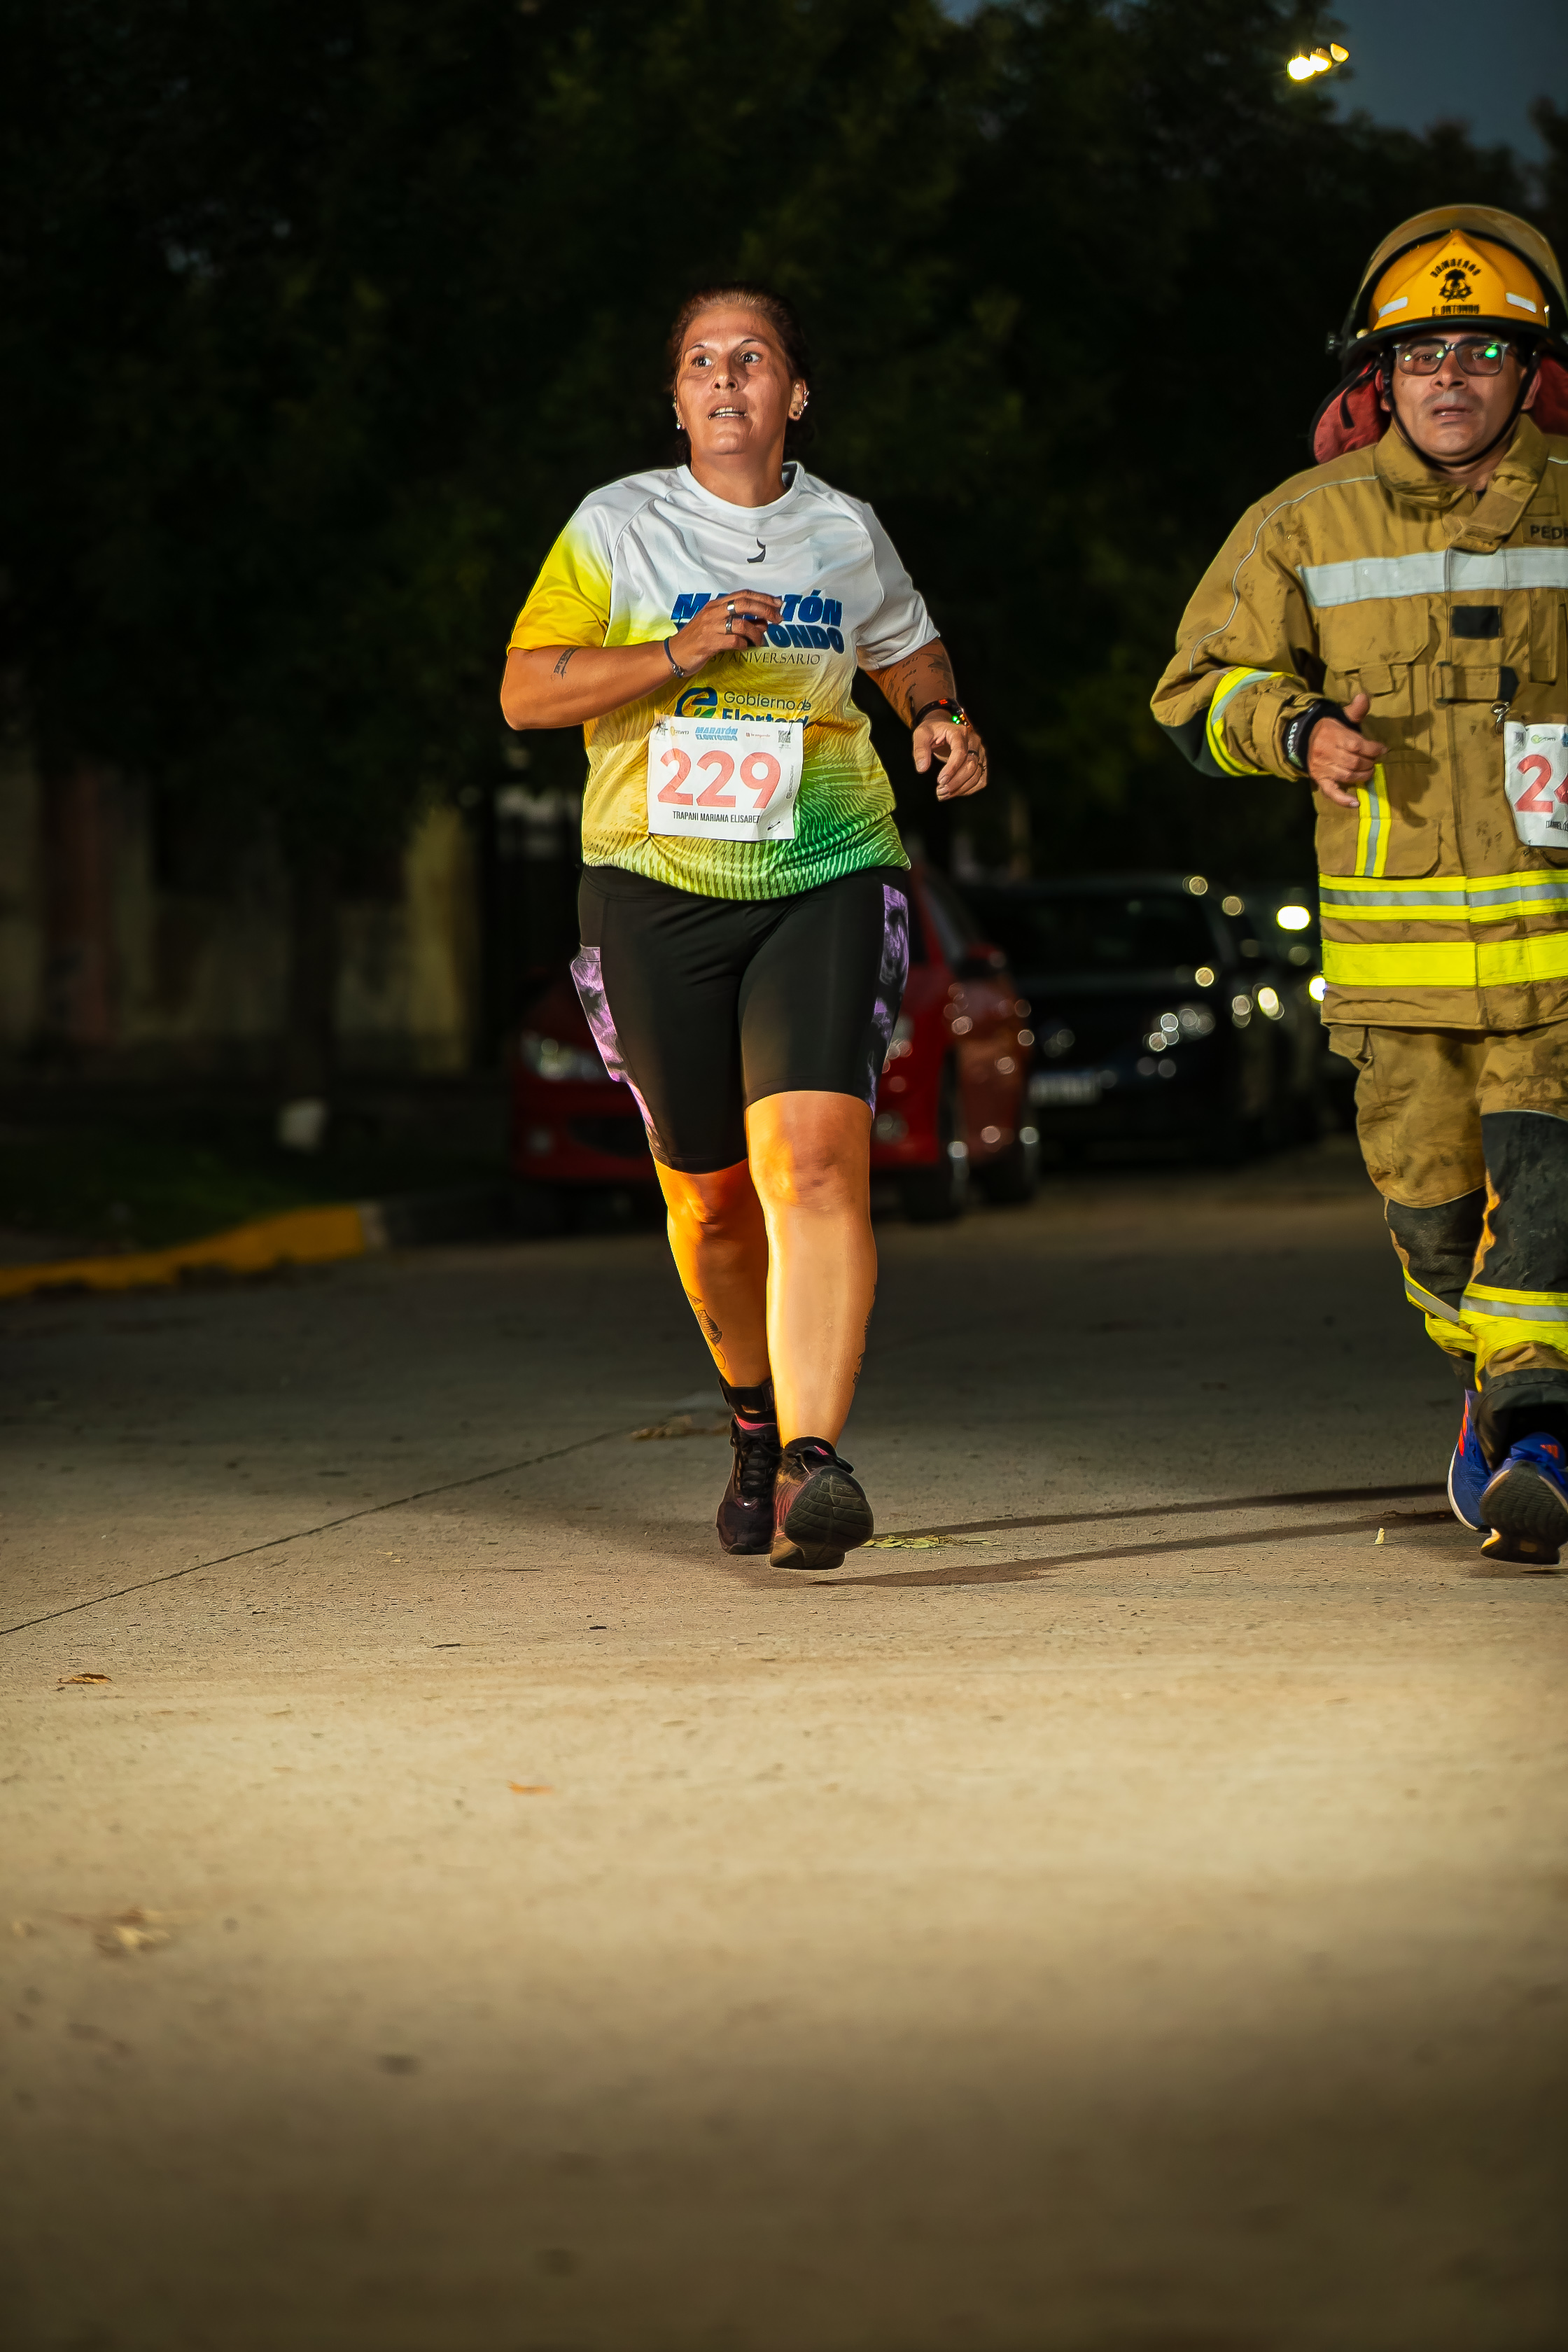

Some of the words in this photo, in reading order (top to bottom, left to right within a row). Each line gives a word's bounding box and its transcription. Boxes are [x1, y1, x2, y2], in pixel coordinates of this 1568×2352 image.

[671, 589, 842, 626] MTÓN
[728, 651, 820, 665] ANIVERSARIO
[724, 690, 796, 710] Gobierno
[657, 748, 781, 809] 229
[673, 811, 699, 821] TRAPANI
[700, 813, 729, 822] MARIANA
